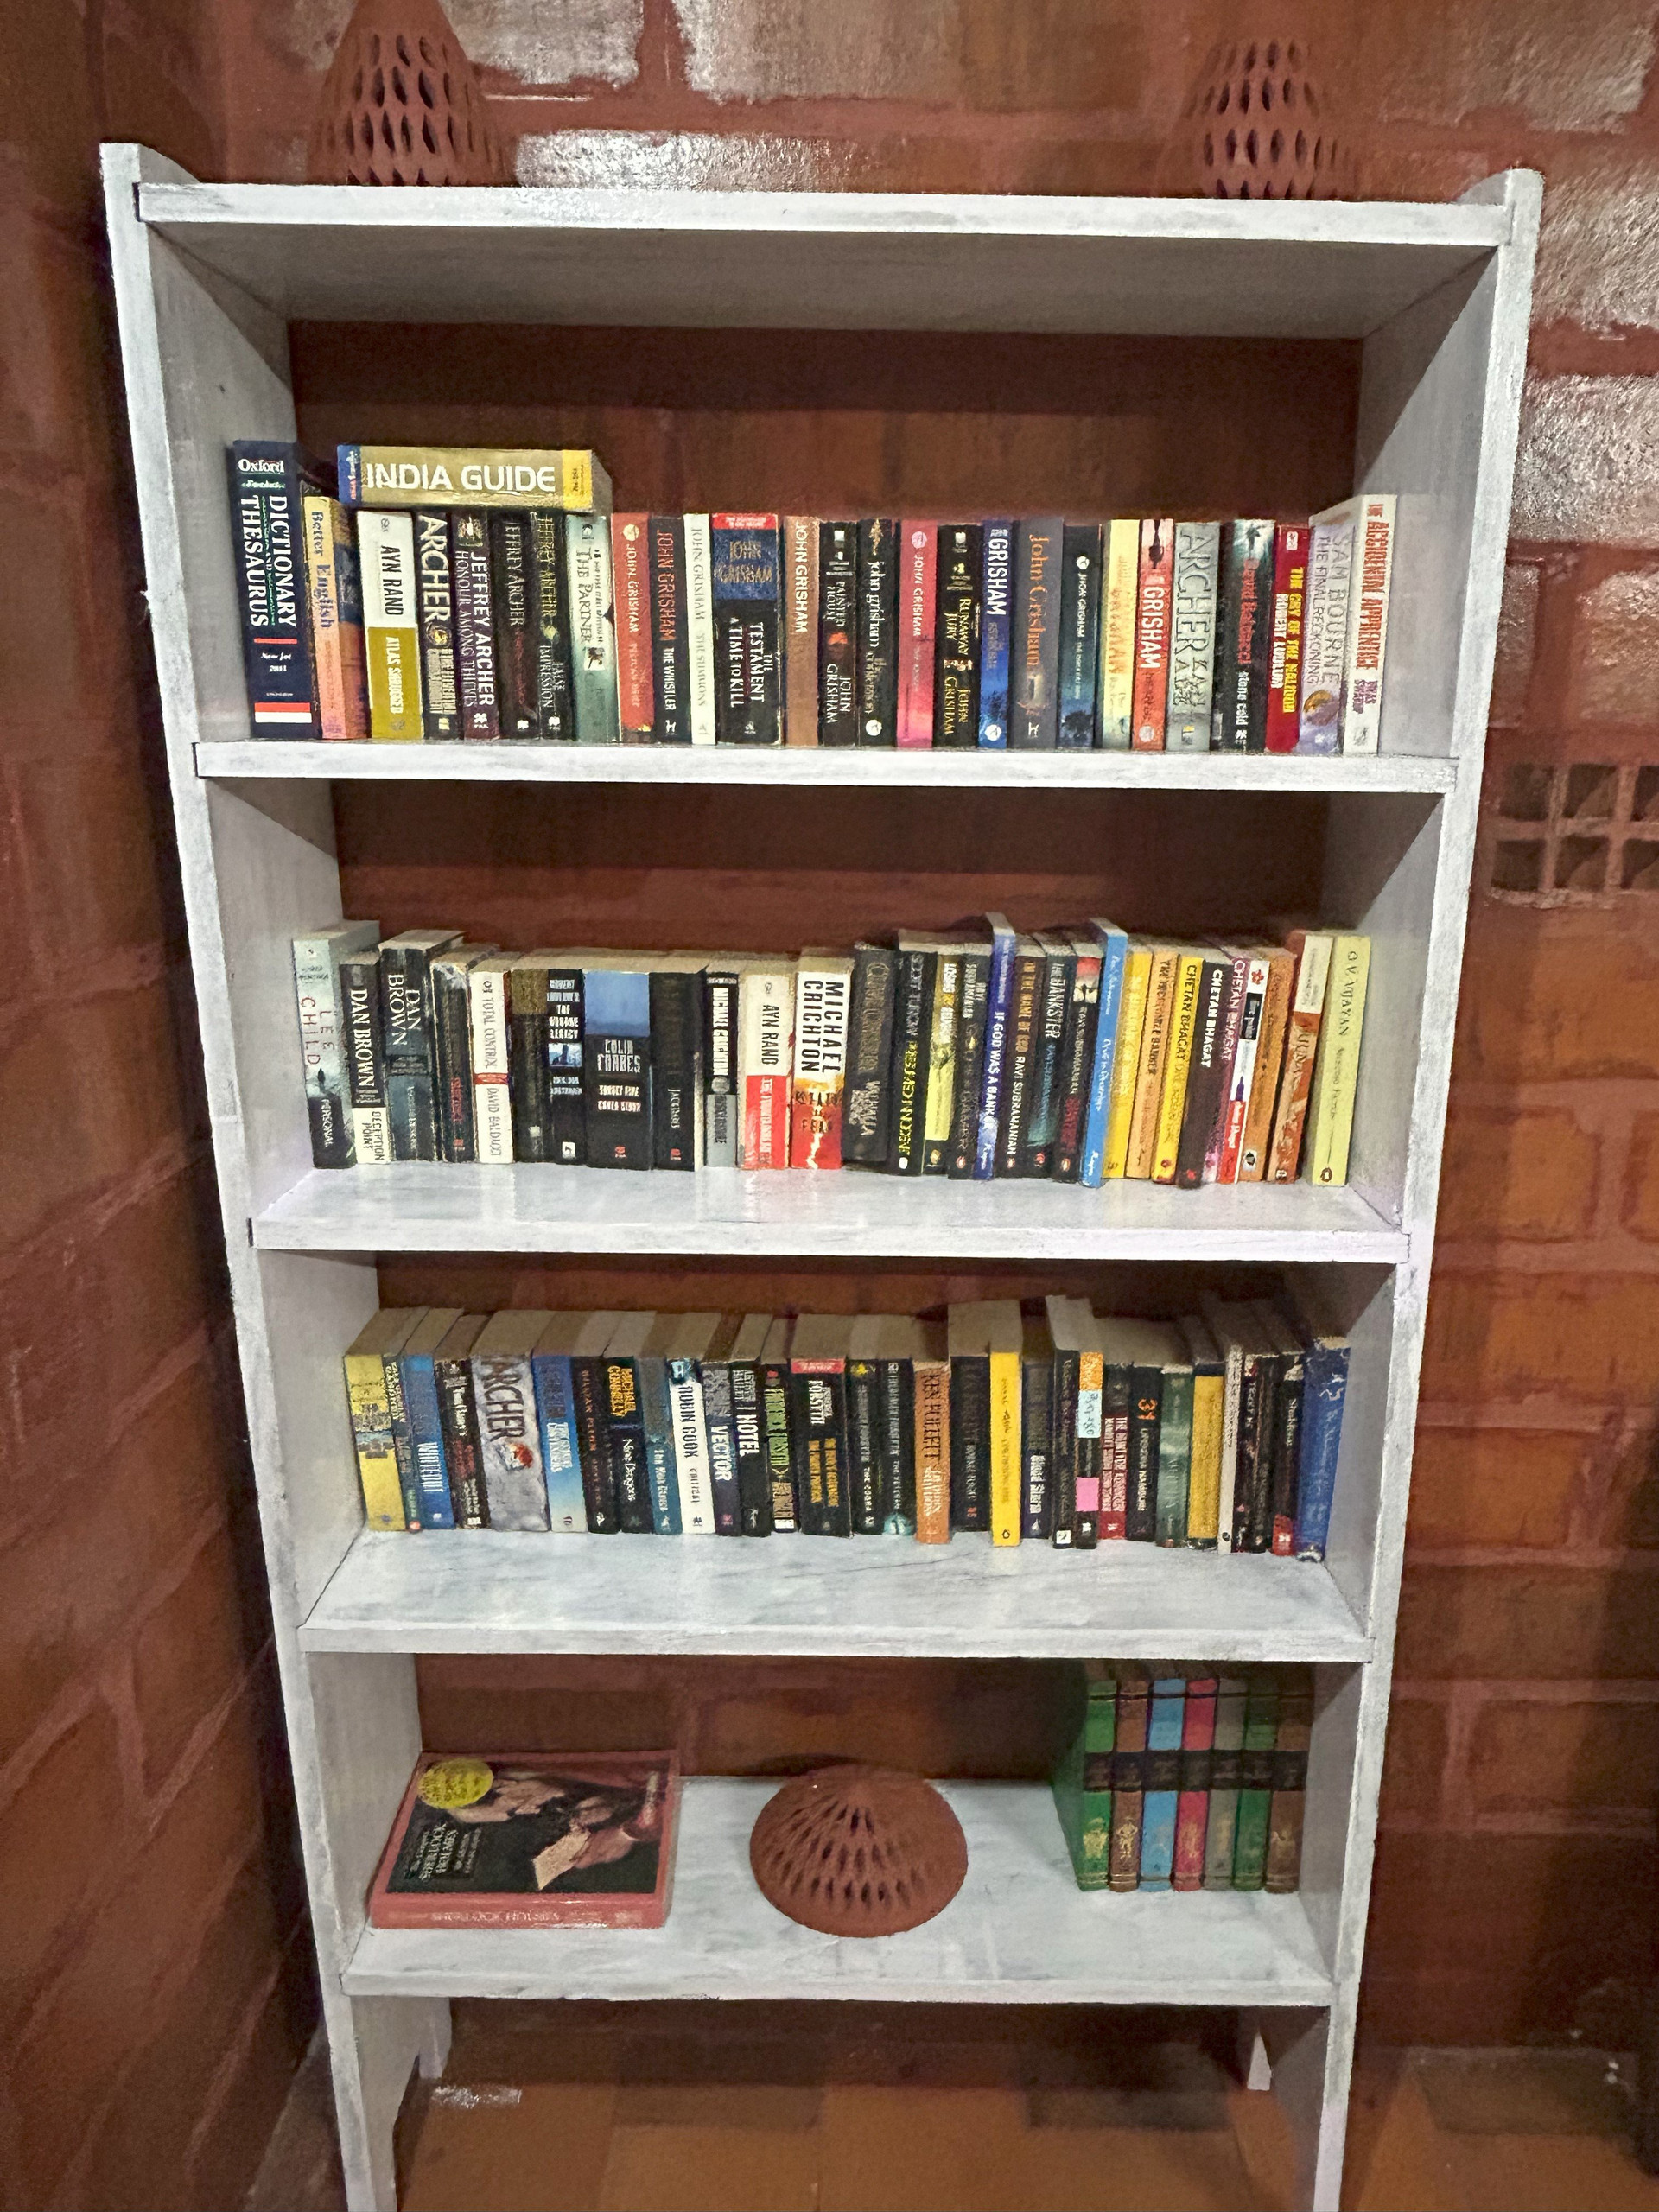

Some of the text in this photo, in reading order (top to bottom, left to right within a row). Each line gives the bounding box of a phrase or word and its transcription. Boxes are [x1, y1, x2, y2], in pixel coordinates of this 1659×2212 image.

[238, 459, 285, 474] Oxford
[365, 463, 454, 490] INDIA
[461, 465, 556, 492] GUIDE
[241, 495, 270, 628] THESAURUS
[269, 495, 297, 628] DICTIONARY
[311, 512, 327, 557] Better
[505, 522, 522, 572] JEFFREY
[1029, 535, 1050, 582] John
[1316, 536, 1330, 562] THE
[315, 565, 334, 629] English
[381, 545, 404, 616] AYN RAND
[418, 515, 451, 623] ARCHER
[455, 550, 472, 606] HONOUR
[541, 570, 557, 617] ARCHER
[576, 548, 594, 644] THE PARTNER
[626, 543, 639, 633] JOHN GRISHAM
[657, 531, 677, 641] JOHN GRISHAM
[691, 529, 707, 620] JOHN GRISHAM
[795, 521, 810, 633] JOHN GRISHAM
[987, 538, 1009, 616] GRISHAM
[1173, 529, 1213, 656] ARCHER
[1290, 567, 1304, 590] THE
[1356, 521, 1390, 671] ACCIDENTAL APPRENTICE
[508, 575, 527, 626] ARCHER
[867, 562, 885, 648] john grisham
[912, 589, 925, 638] GRISHAM
[945, 613, 959, 642] JURY
[957, 599, 972, 656] RUNAWAY
[1140, 587, 1166, 668] GRISHAM
[1321, 534, 1350, 684] SAM BOURNE
[385, 637, 401, 665] ATLAS
[459, 610, 474, 657] AMONG
[471, 552, 495, 706] JEFFREY ARCHER
[729, 626, 744, 660] TIME
[1286, 639, 1300, 660] THE
[540, 646, 554, 708] IMPRESSION
[664, 648, 677, 711] THE WHISTLER
[750, 622, 765, 703] TESTAMENT
[764, 654, 773, 671] THE
[730, 678, 745, 708] KILL
[826, 664, 839, 725] GRISHAM
[840, 677, 852, 713] JOHN
[944, 677, 958, 735] GRISHAM
[958, 689, 971, 723] JOHN
[1236, 671, 1249, 725] stone cold
[387, 974, 408, 1046] BROWN
[404, 988, 423, 1031] DAN
[1044, 976, 1066, 1037] BANKSTER
[1180, 964, 1198, 1012] CHETAN
[1228, 959, 1247, 1009] CHETAN
[1338, 981, 1357, 1037] VIJAYAN
[301, 996, 321, 1065] CHILD
[320, 1010, 335, 1052] LEE
[350, 988, 375, 1087] DAN BROWN
[761, 1004, 780, 1065] AYN RAND
[801, 980, 823, 1072] CRICHTON
[823, 981, 845, 1074] MICHAEL
[992, 1023, 1005, 1046] GOD
[994, 1011, 1006, 1021] IF
[1199, 969, 1224, 1068] CHETAN BHAGAT
[597, 1055, 641, 1074] FORBES
[988, 1049, 1001, 1074] WAS
[988, 1076, 999, 1084] A
[320, 1098, 334, 1148] PERSONAL
[486, 1087, 499, 1114] DAVID
[1007, 1056, 1026, 1154] RAVI SUBRAMANIAN
[360, 1122, 374, 1151] POINT
[481, 1355, 527, 1442] ARCHER
[678, 1386, 697, 1423] ROBIN
[921, 1374, 943, 1461] KEN FOLLETT
[1136, 1397, 1159, 1421] 31
[681, 1427, 699, 1459] COOK
[711, 1425, 733, 1481] VECTOR
[735, 1414, 760, 1458] HOTEL
